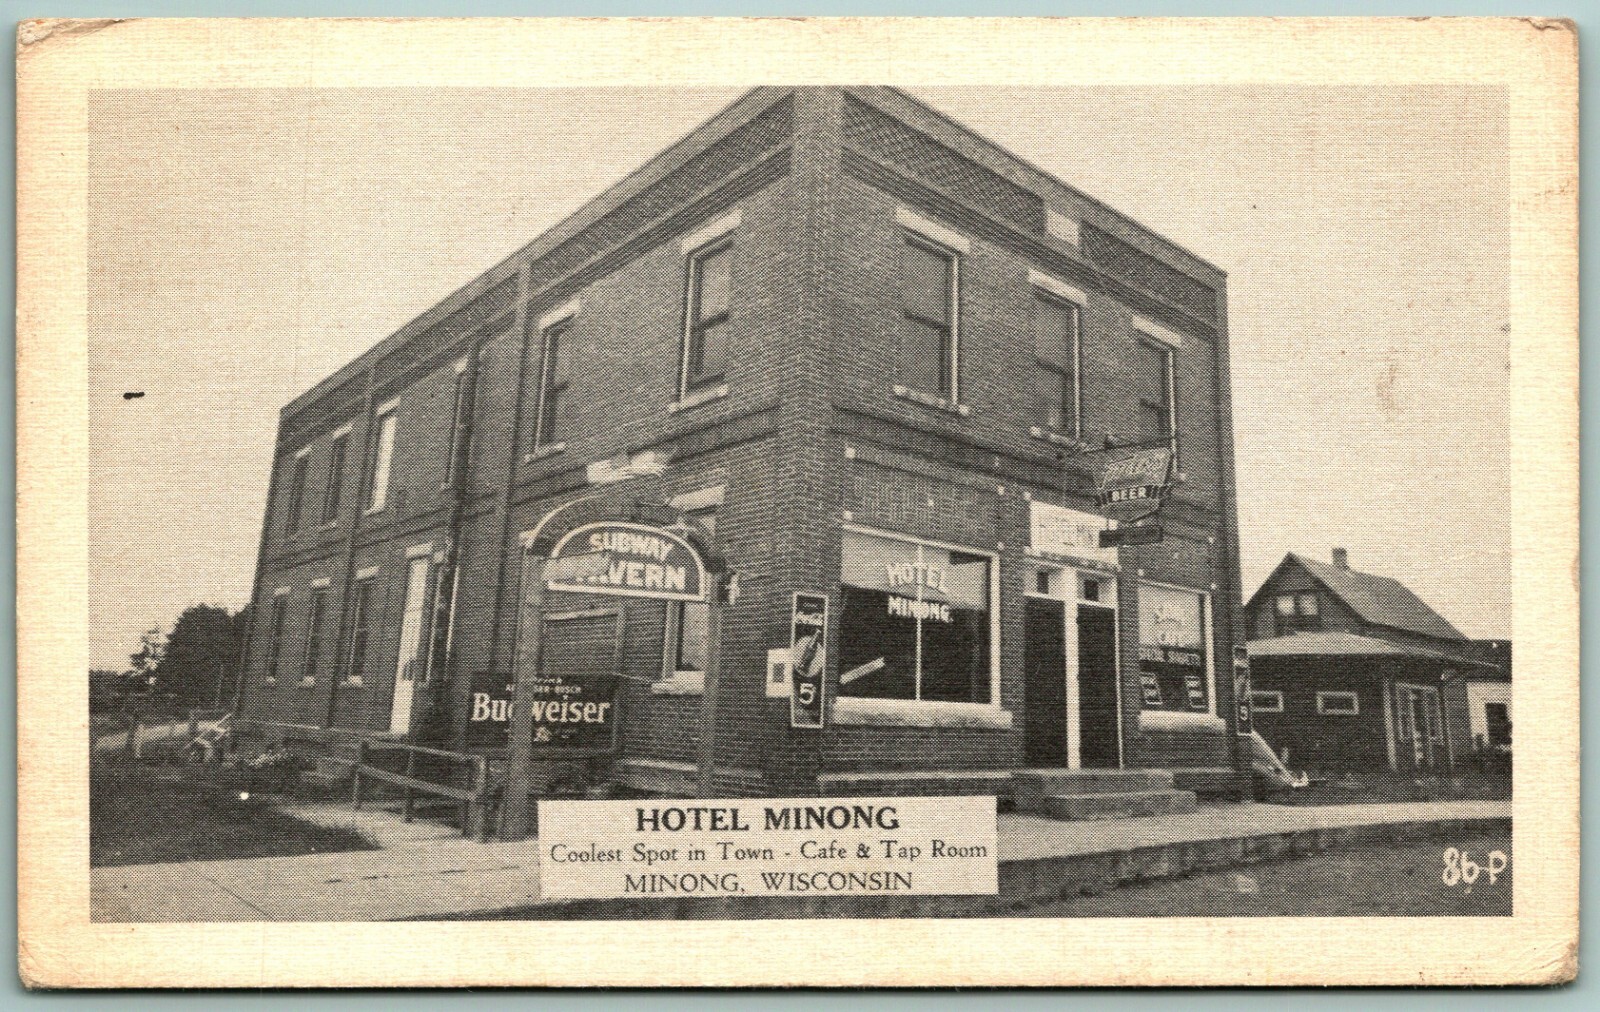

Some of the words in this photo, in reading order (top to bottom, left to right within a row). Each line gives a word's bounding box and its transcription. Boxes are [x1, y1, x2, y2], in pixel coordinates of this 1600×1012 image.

[1111, 487, 1147, 502] BEER
[588, 531, 674, 562] SUBWAY
[572, 560, 687, 591] VERN
[886, 561, 949, 594] HOTEL
[887, 595, 952, 624] MINONG
